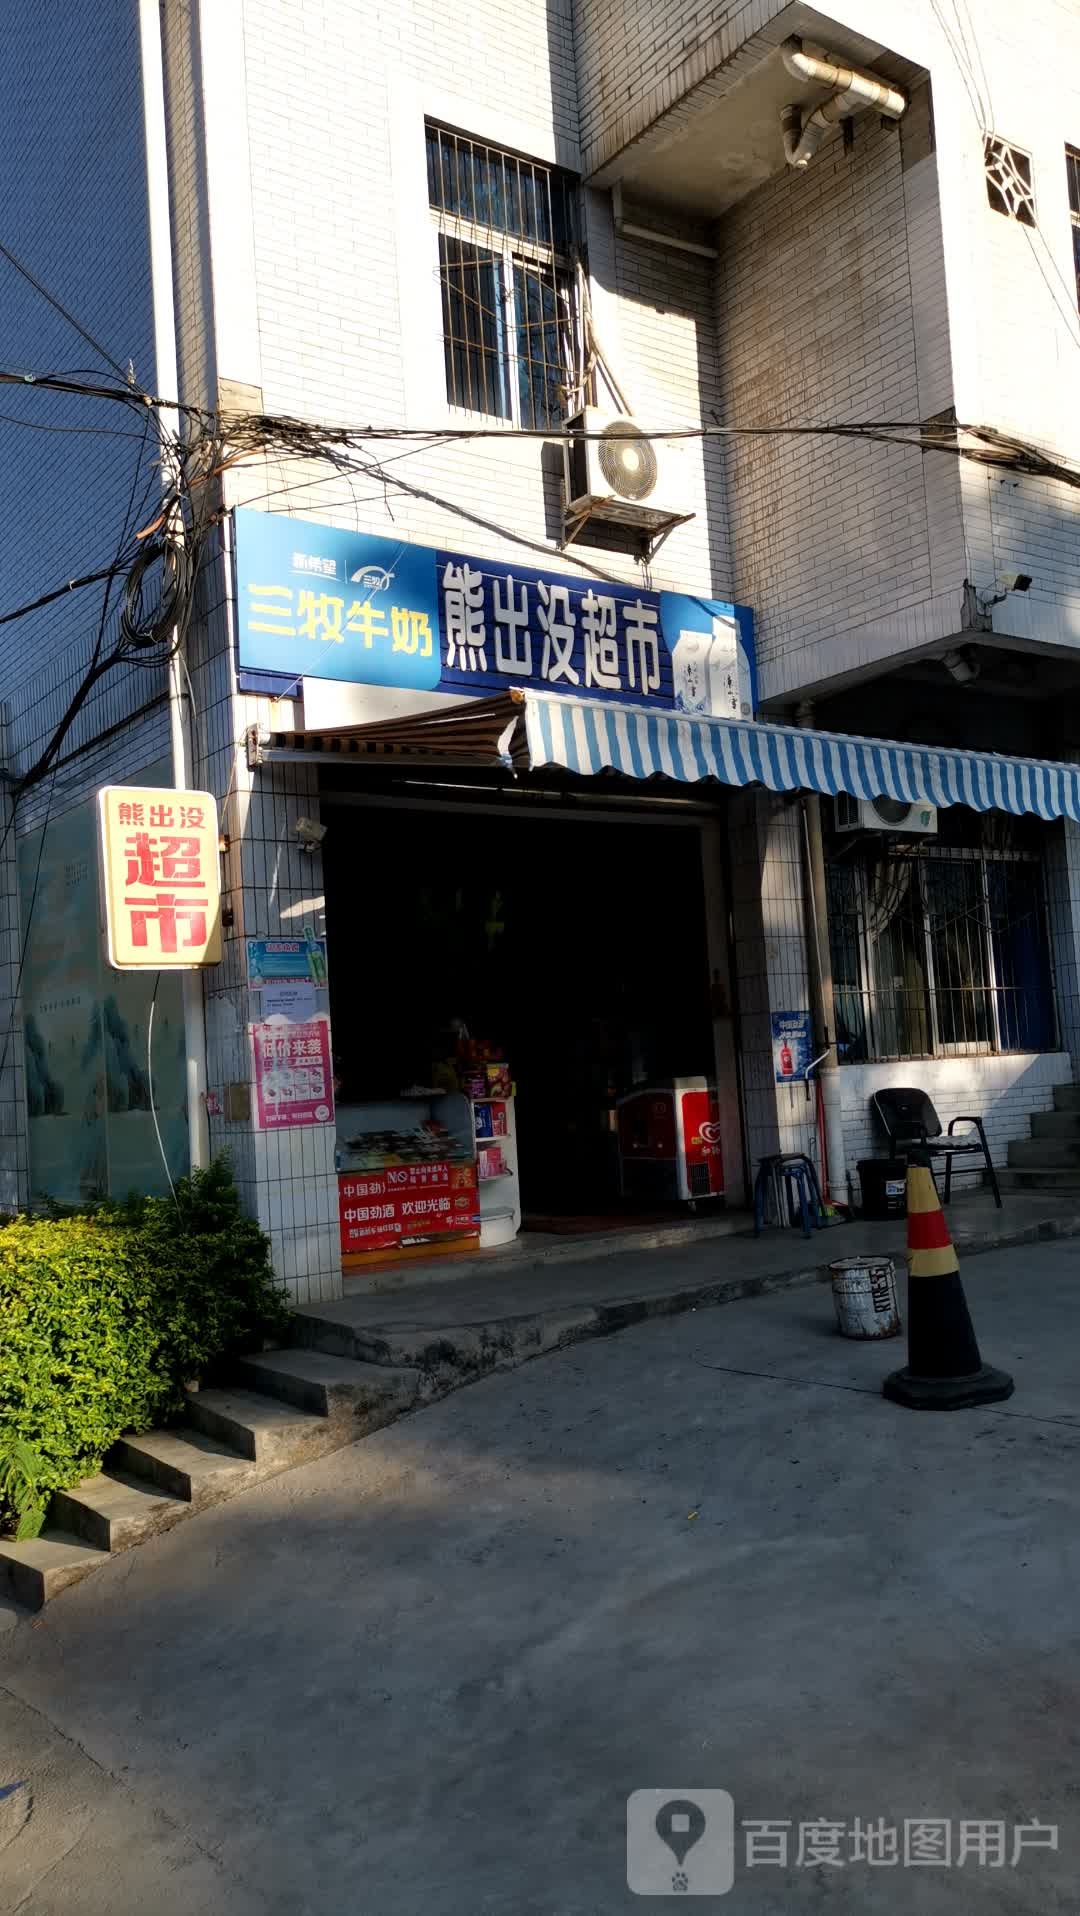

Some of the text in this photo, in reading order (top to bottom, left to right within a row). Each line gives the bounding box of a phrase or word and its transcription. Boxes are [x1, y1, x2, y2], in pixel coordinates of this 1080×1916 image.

[247, 582, 433, 657] 三牧牛奶
[442, 560, 661, 696] 熊出没超市
[117, 802, 206, 829] 熊出没
[124, 831, 209, 953] 超市
[343, 1182, 386, 1198] 中国劲
[344, 1204, 395, 1222] 中国劲酒
[402, 1198, 451, 1215] 欢迎光临
